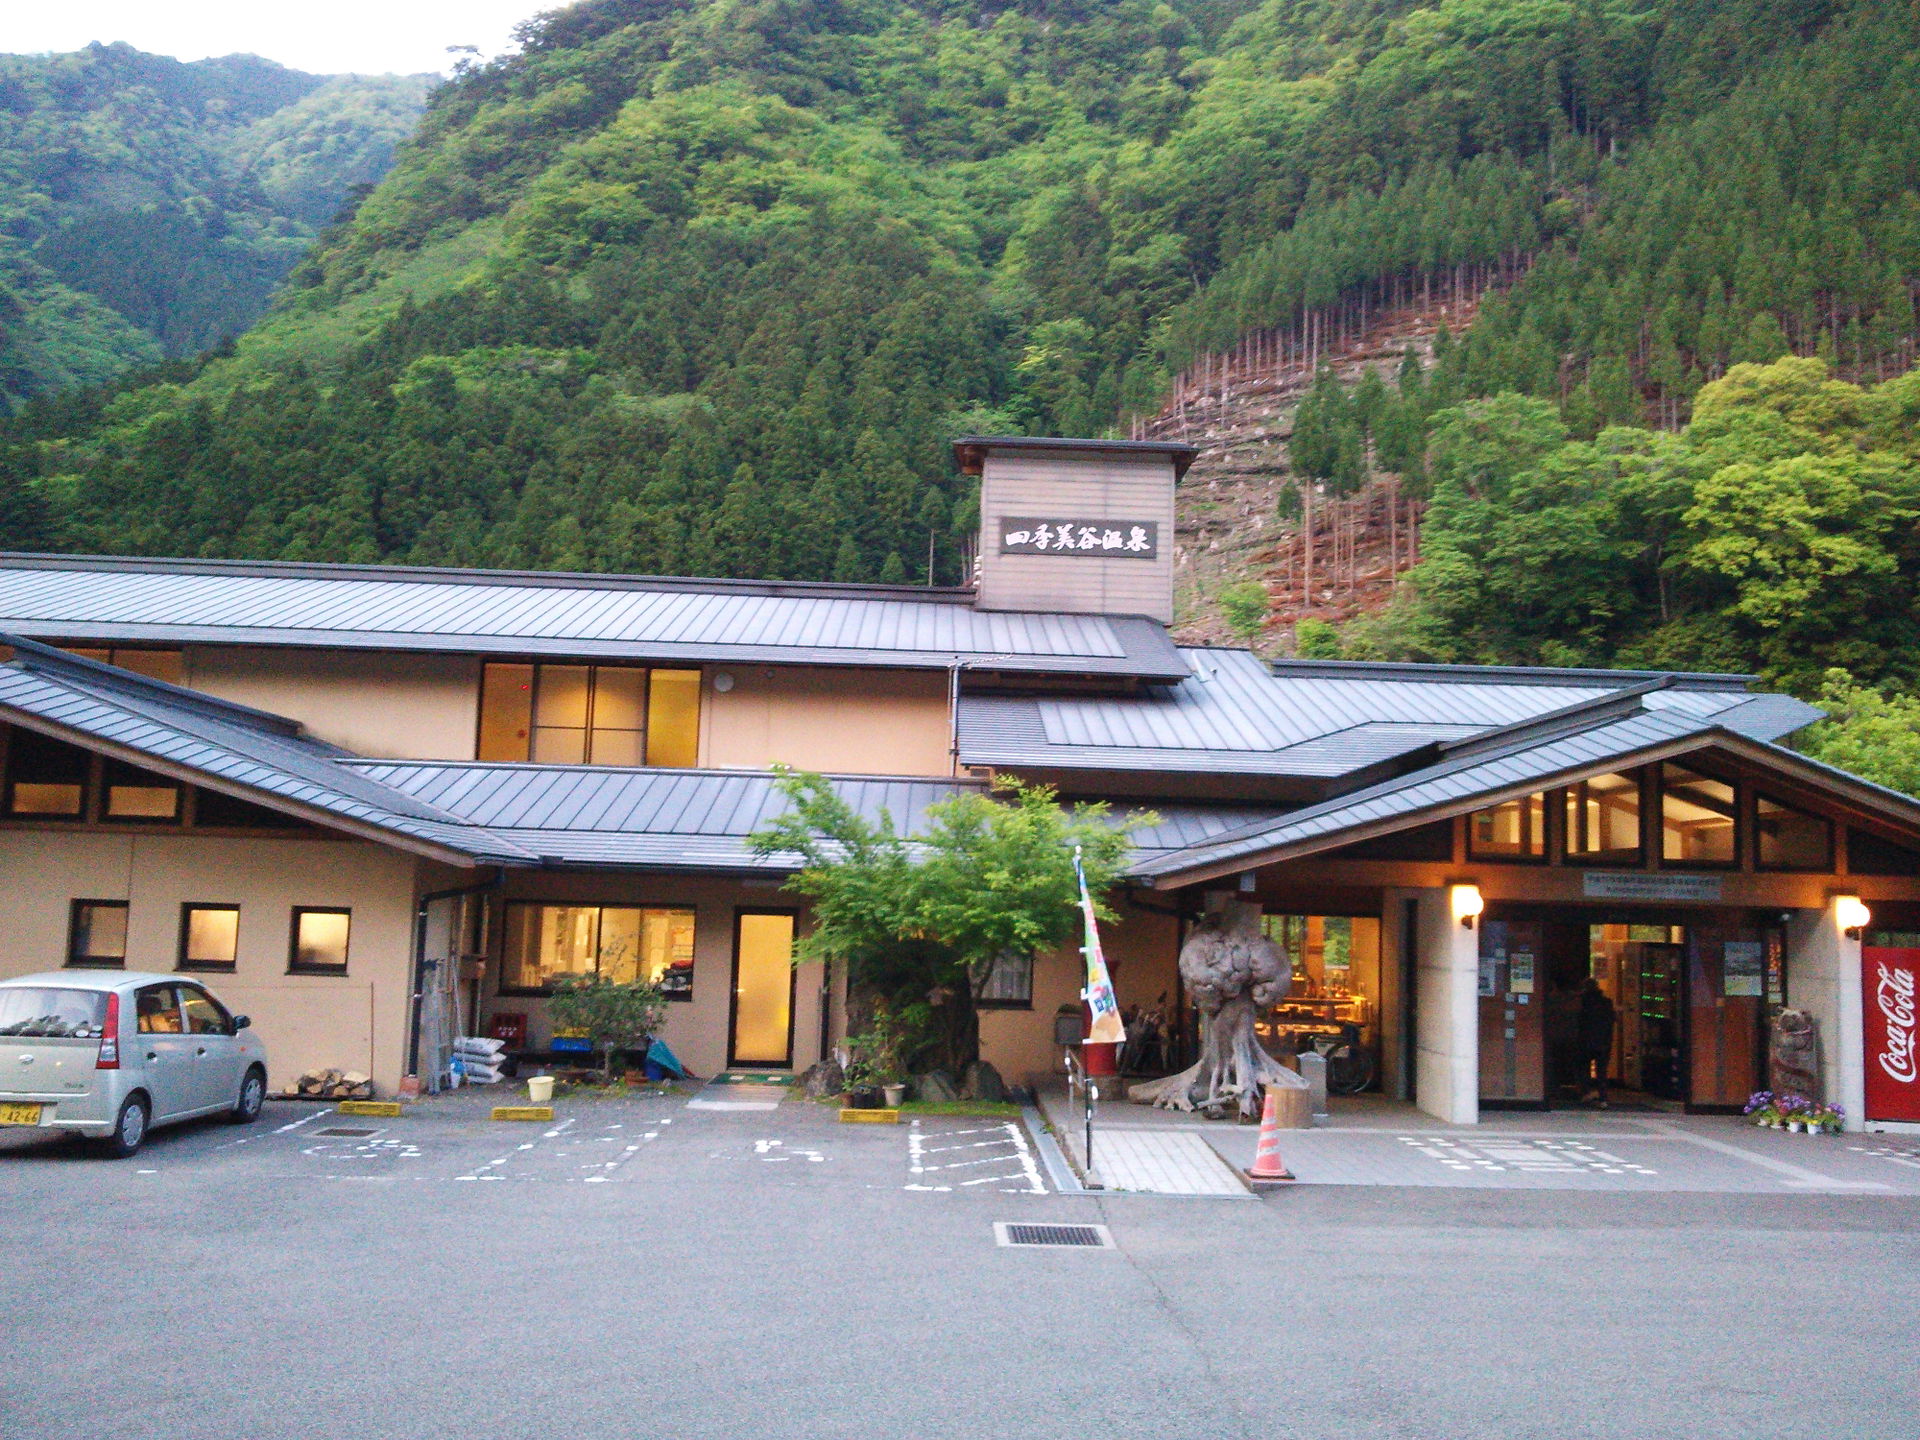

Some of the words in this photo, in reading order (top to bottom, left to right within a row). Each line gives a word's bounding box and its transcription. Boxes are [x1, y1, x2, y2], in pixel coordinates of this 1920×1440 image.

[1005, 523, 1151, 551] 四季美谷温泉
[1877, 961, 1917, 1083] Coca-Cola
